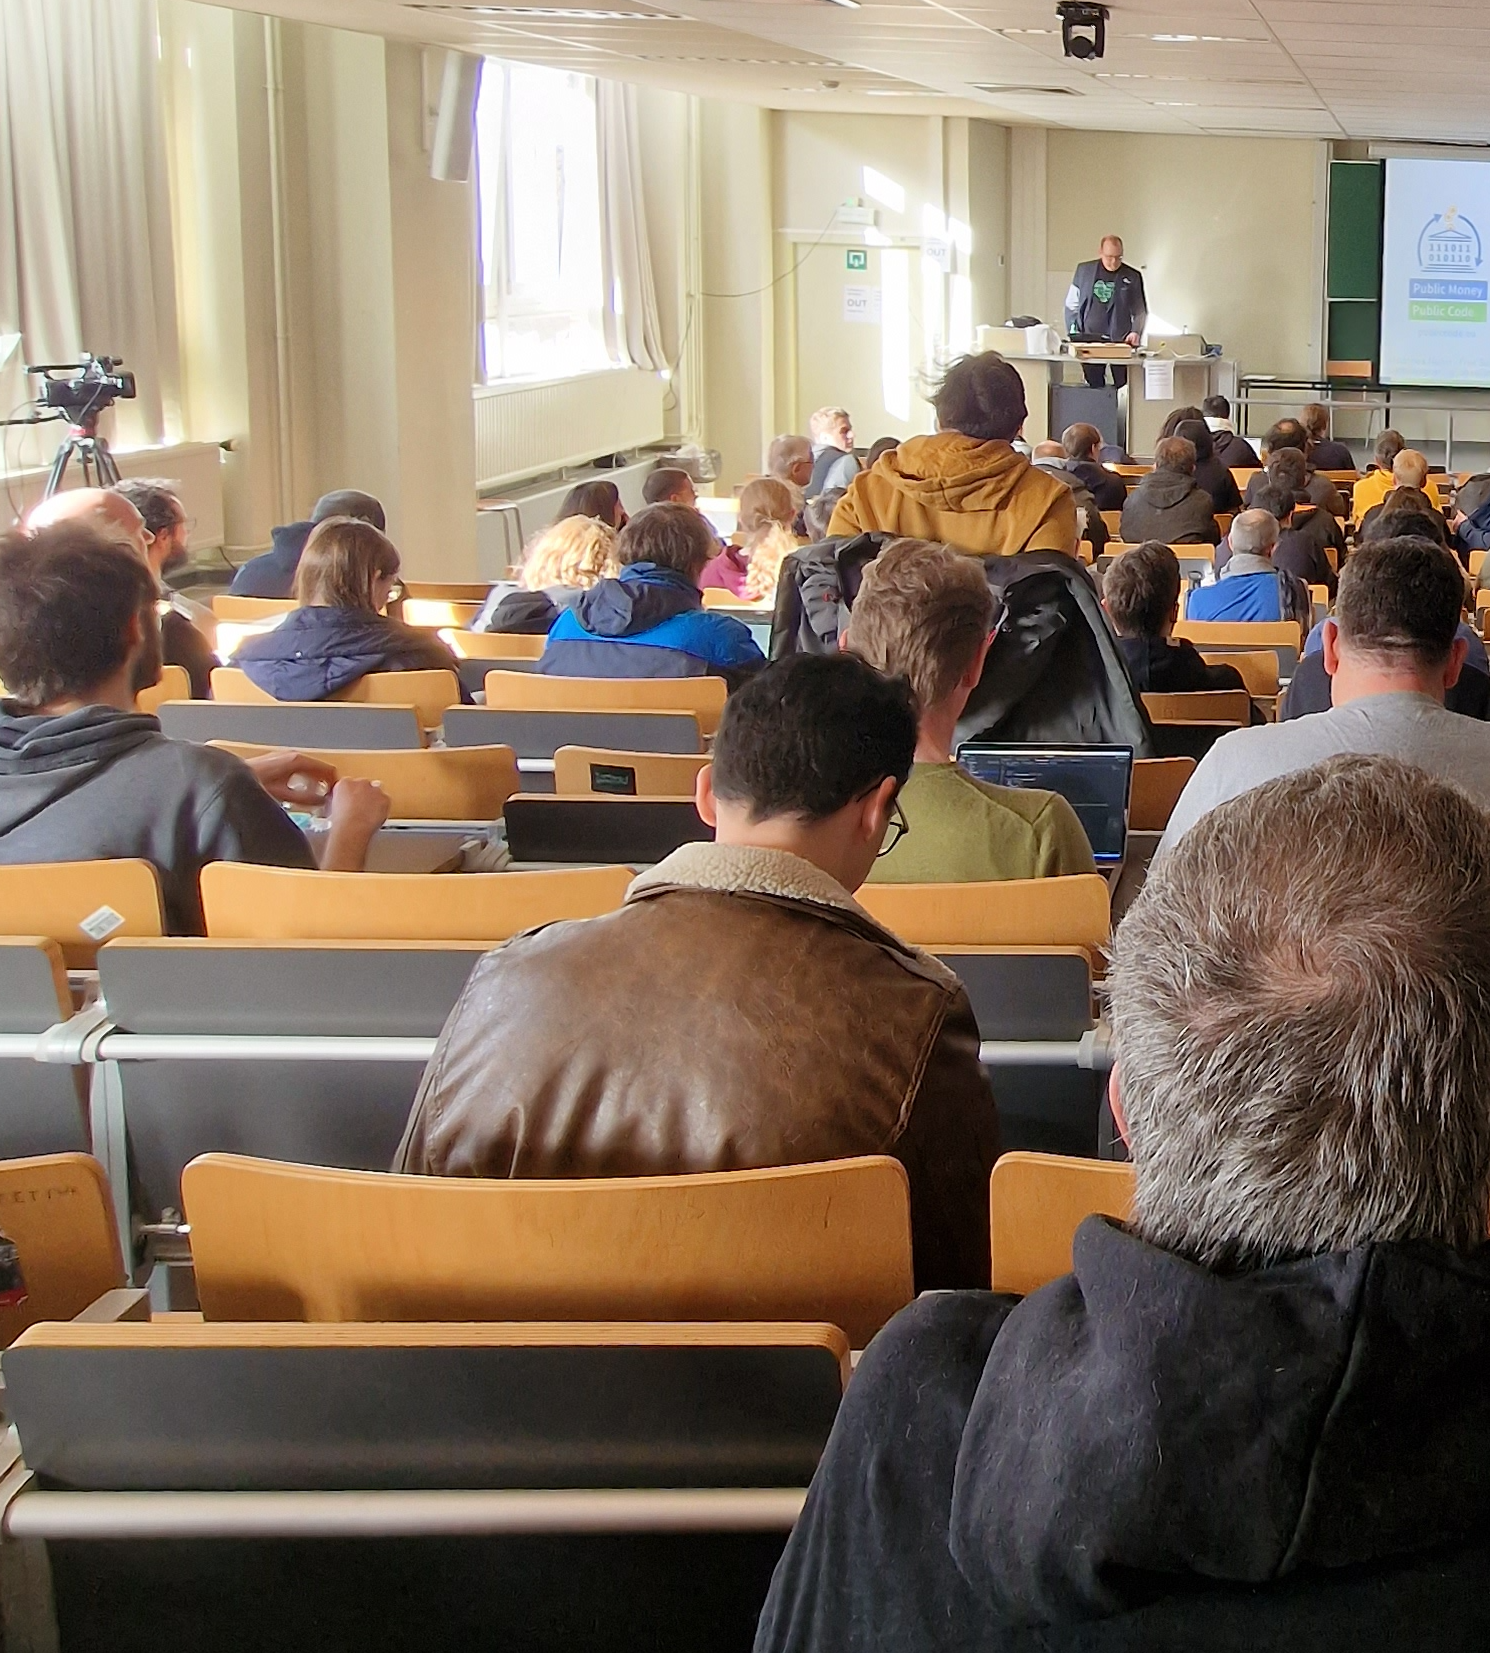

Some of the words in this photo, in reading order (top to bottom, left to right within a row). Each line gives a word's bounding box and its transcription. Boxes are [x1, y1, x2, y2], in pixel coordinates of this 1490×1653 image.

[927, 248, 946, 256] OUT
[1413, 282, 1446, 295] Public
[1447, 284, 1483, 299] Money
[847, 299, 867, 307] OUT
[1412, 305, 1445, 317] Public
[1447, 306, 1475, 318] Code
